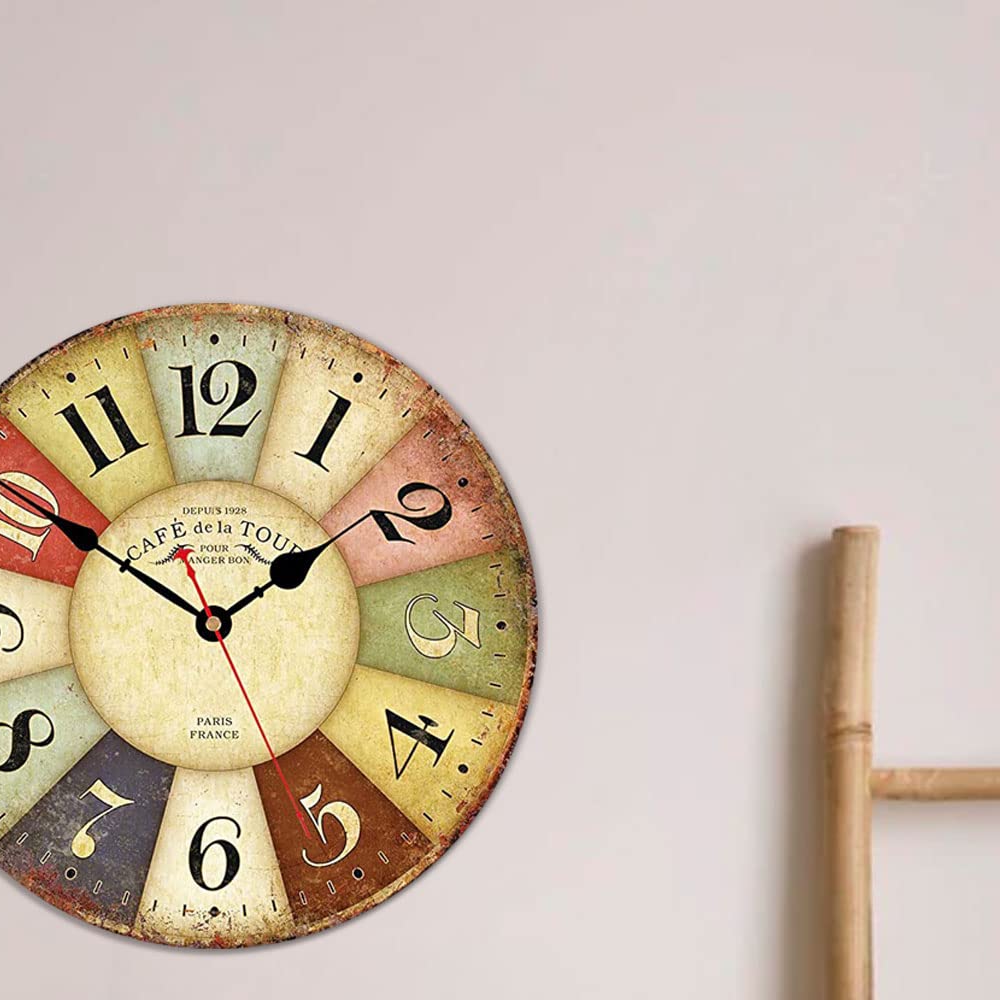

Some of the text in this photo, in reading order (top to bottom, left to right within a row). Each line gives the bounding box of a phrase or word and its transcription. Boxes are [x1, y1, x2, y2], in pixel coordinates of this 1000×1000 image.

[54, 384, 149, 478] 11
[167, 359, 262, 438] 12
[294, 389, 352, 473] 1
[126, 517, 187, 561] CAFÉ
[193, 520, 214, 535] de
[217, 520, 232, 535] la
[182, 506, 248, 515] DEPUIS 1928
[369, 481, 453, 545] 2
[178, 556, 226, 565] ANGER
[199, 544, 229, 553] POUR
[404, 593, 483, 659] 3
[189, 729, 240, 740] FRANCE
[196, 716, 233, 727] PARIS
[384, 707, 456, 780] 4
[70, 778, 135, 859] 7
[300, 782, 362, 867] 5
[188, 815, 242, 892] 6
